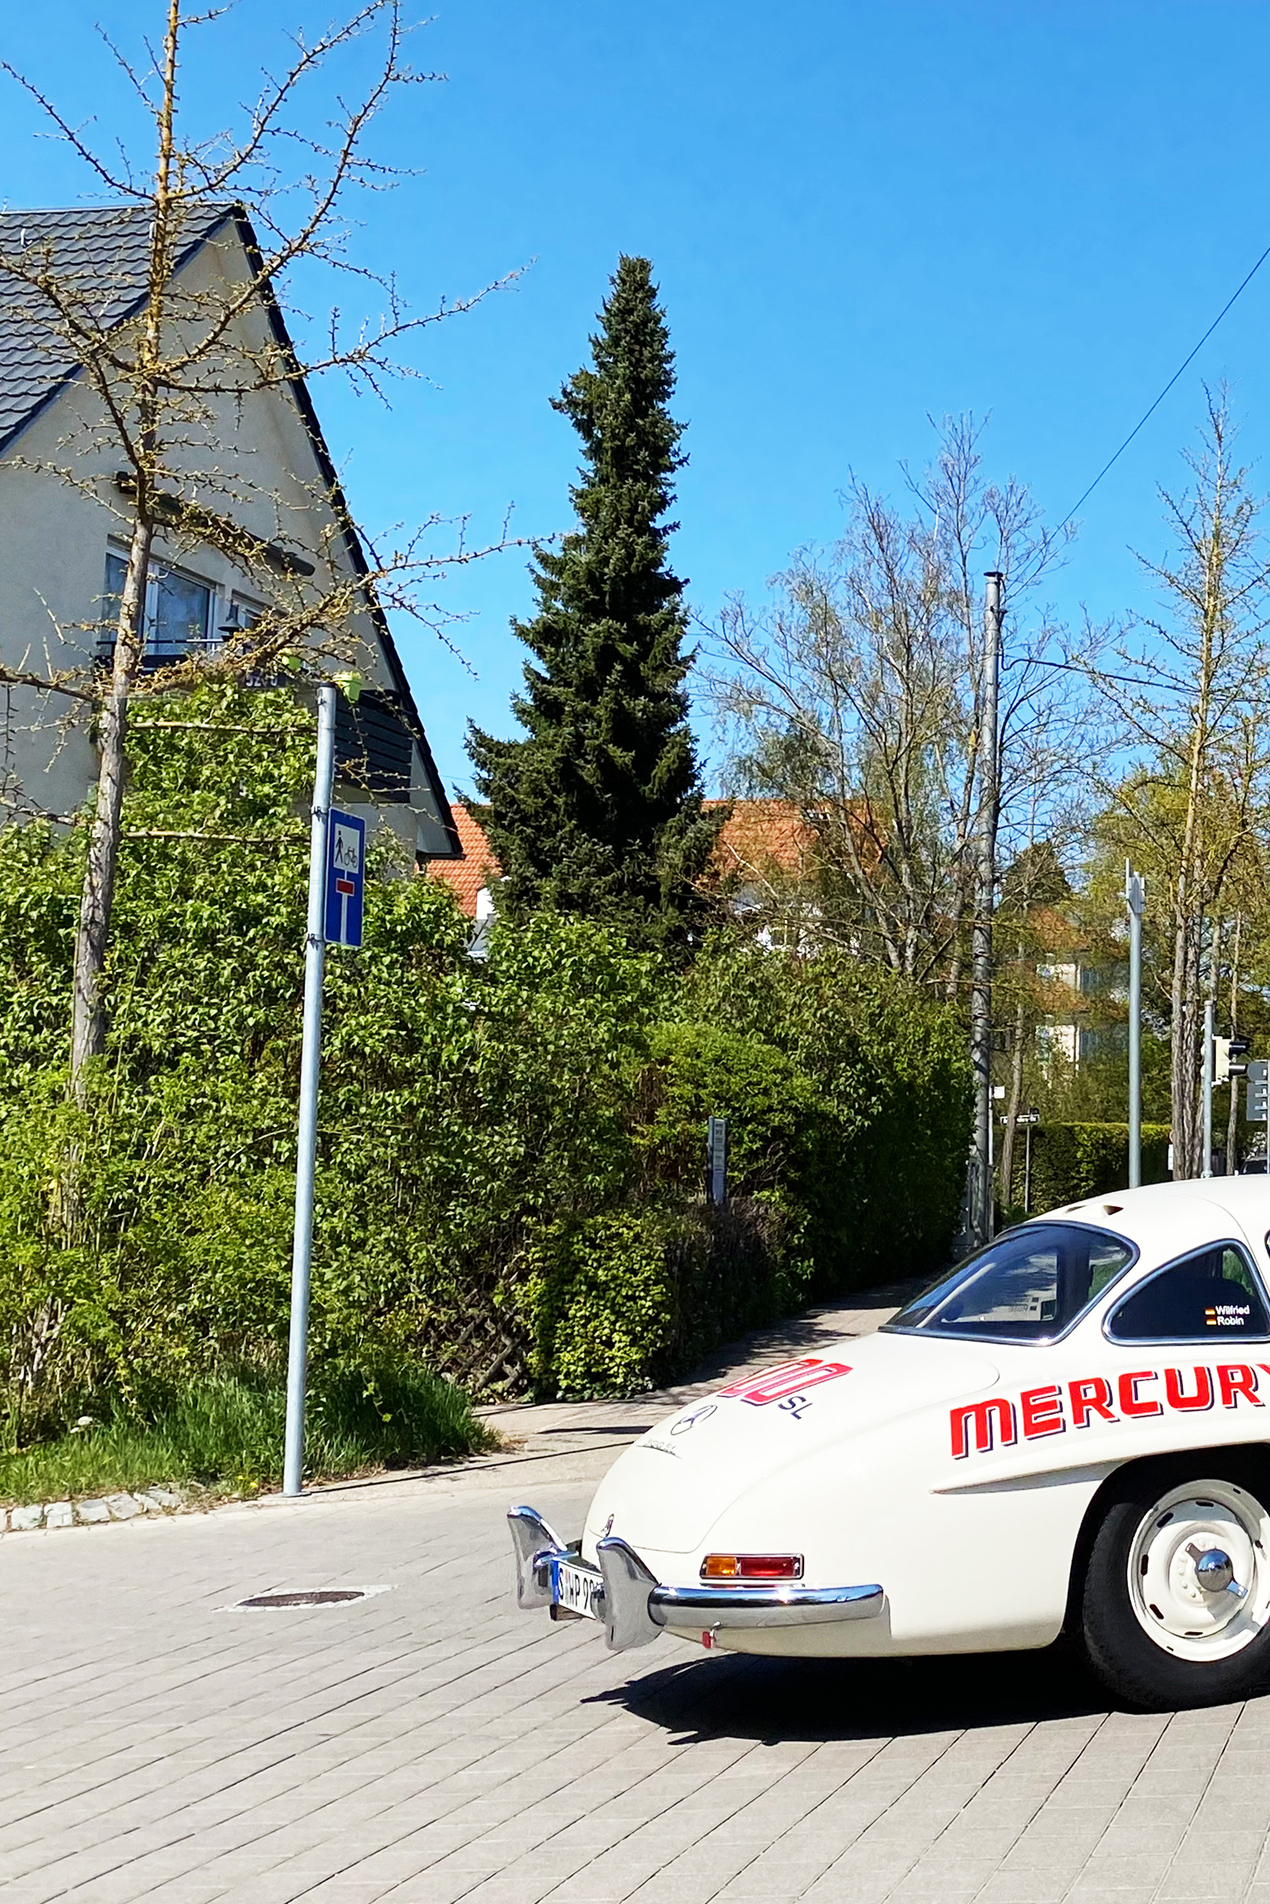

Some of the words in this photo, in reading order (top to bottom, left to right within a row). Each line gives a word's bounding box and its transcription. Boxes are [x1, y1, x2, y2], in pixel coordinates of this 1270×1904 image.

[1215, 1305, 1250, 1315] Wilfried
[1217, 1316, 1244, 1325] Robin
[778, 1395, 813, 1420] SL
